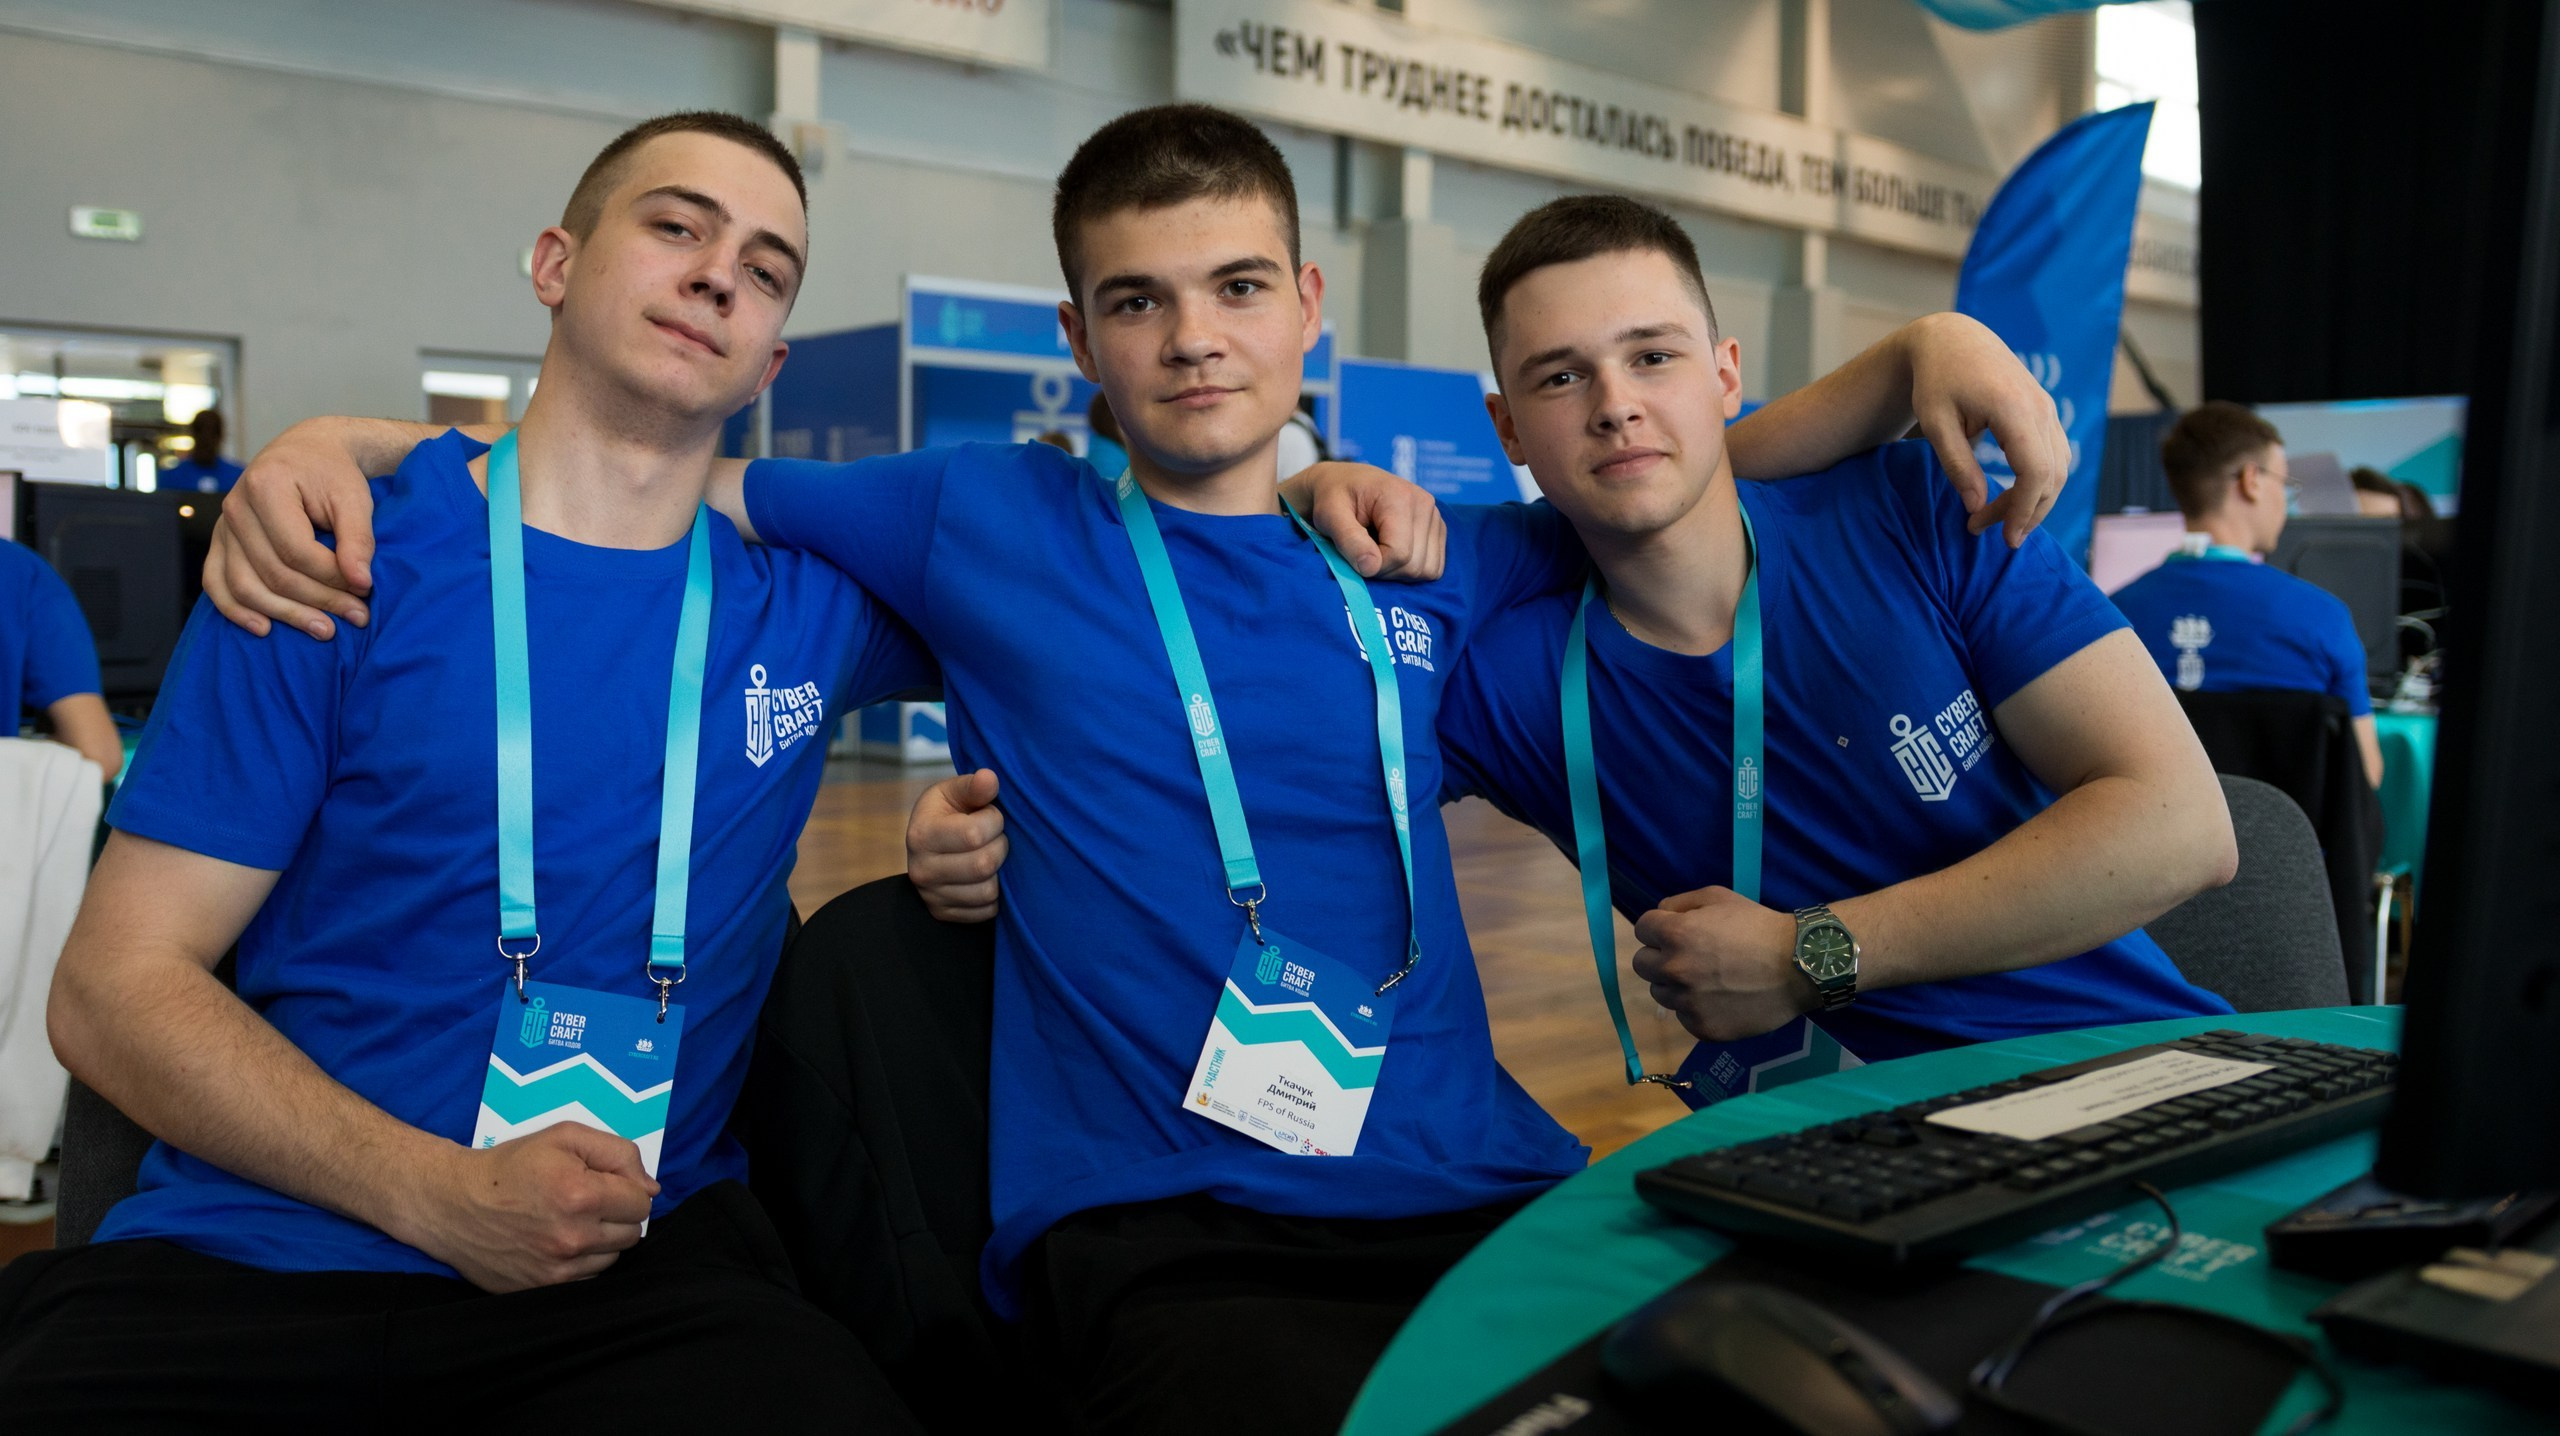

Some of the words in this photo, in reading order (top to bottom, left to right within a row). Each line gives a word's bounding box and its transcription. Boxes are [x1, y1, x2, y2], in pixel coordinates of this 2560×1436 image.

[1213, 19, 1325, 87] «ЧЕМ
[1337, 42, 1490, 121] ТРУДНЕЕ
[1499, 82, 1676, 161] ДОСТАЛАСЬ
[1390, 606, 1432, 635] CYBER
[1394, 630, 1432, 660] CRAFT
[771, 681, 820, 713] CYBER
[773, 698, 823, 738] CRAFT
[1934, 689, 1979, 737] CYBER
[779, 729, 804, 751] БИТВА
[1197, 736, 1221, 750] CYBER
[1948, 709, 1988, 759] CRAFT
[1199, 746, 1222, 758] CRAFT
[1961, 749, 1982, 772] БИТВА
[1737, 801, 1758, 811] CYBER
[1737, 810, 1758, 820] CRAFT
[1282, 971, 1313, 992] CRAFT
[1285, 961, 1316, 982] CYBER
[552, 1011, 587, 1029] CYBER
[550, 1025, 584, 1042] CRAFT
[1203, 1046, 1227, 1089] УЧАСТНИК
[1709, 1050, 1733, 1076] CYBER
[1717, 1058, 1741, 1085] CRAFT
[1266, 1083, 1317, 1111] Дмитрий
[1278, 1074, 1314, 1097] Ткачук
[1257, 1097, 1274, 1111] FPS
[1275, 1106, 1287, 1117] of
[1286, 1111, 1316, 1130] Russia
